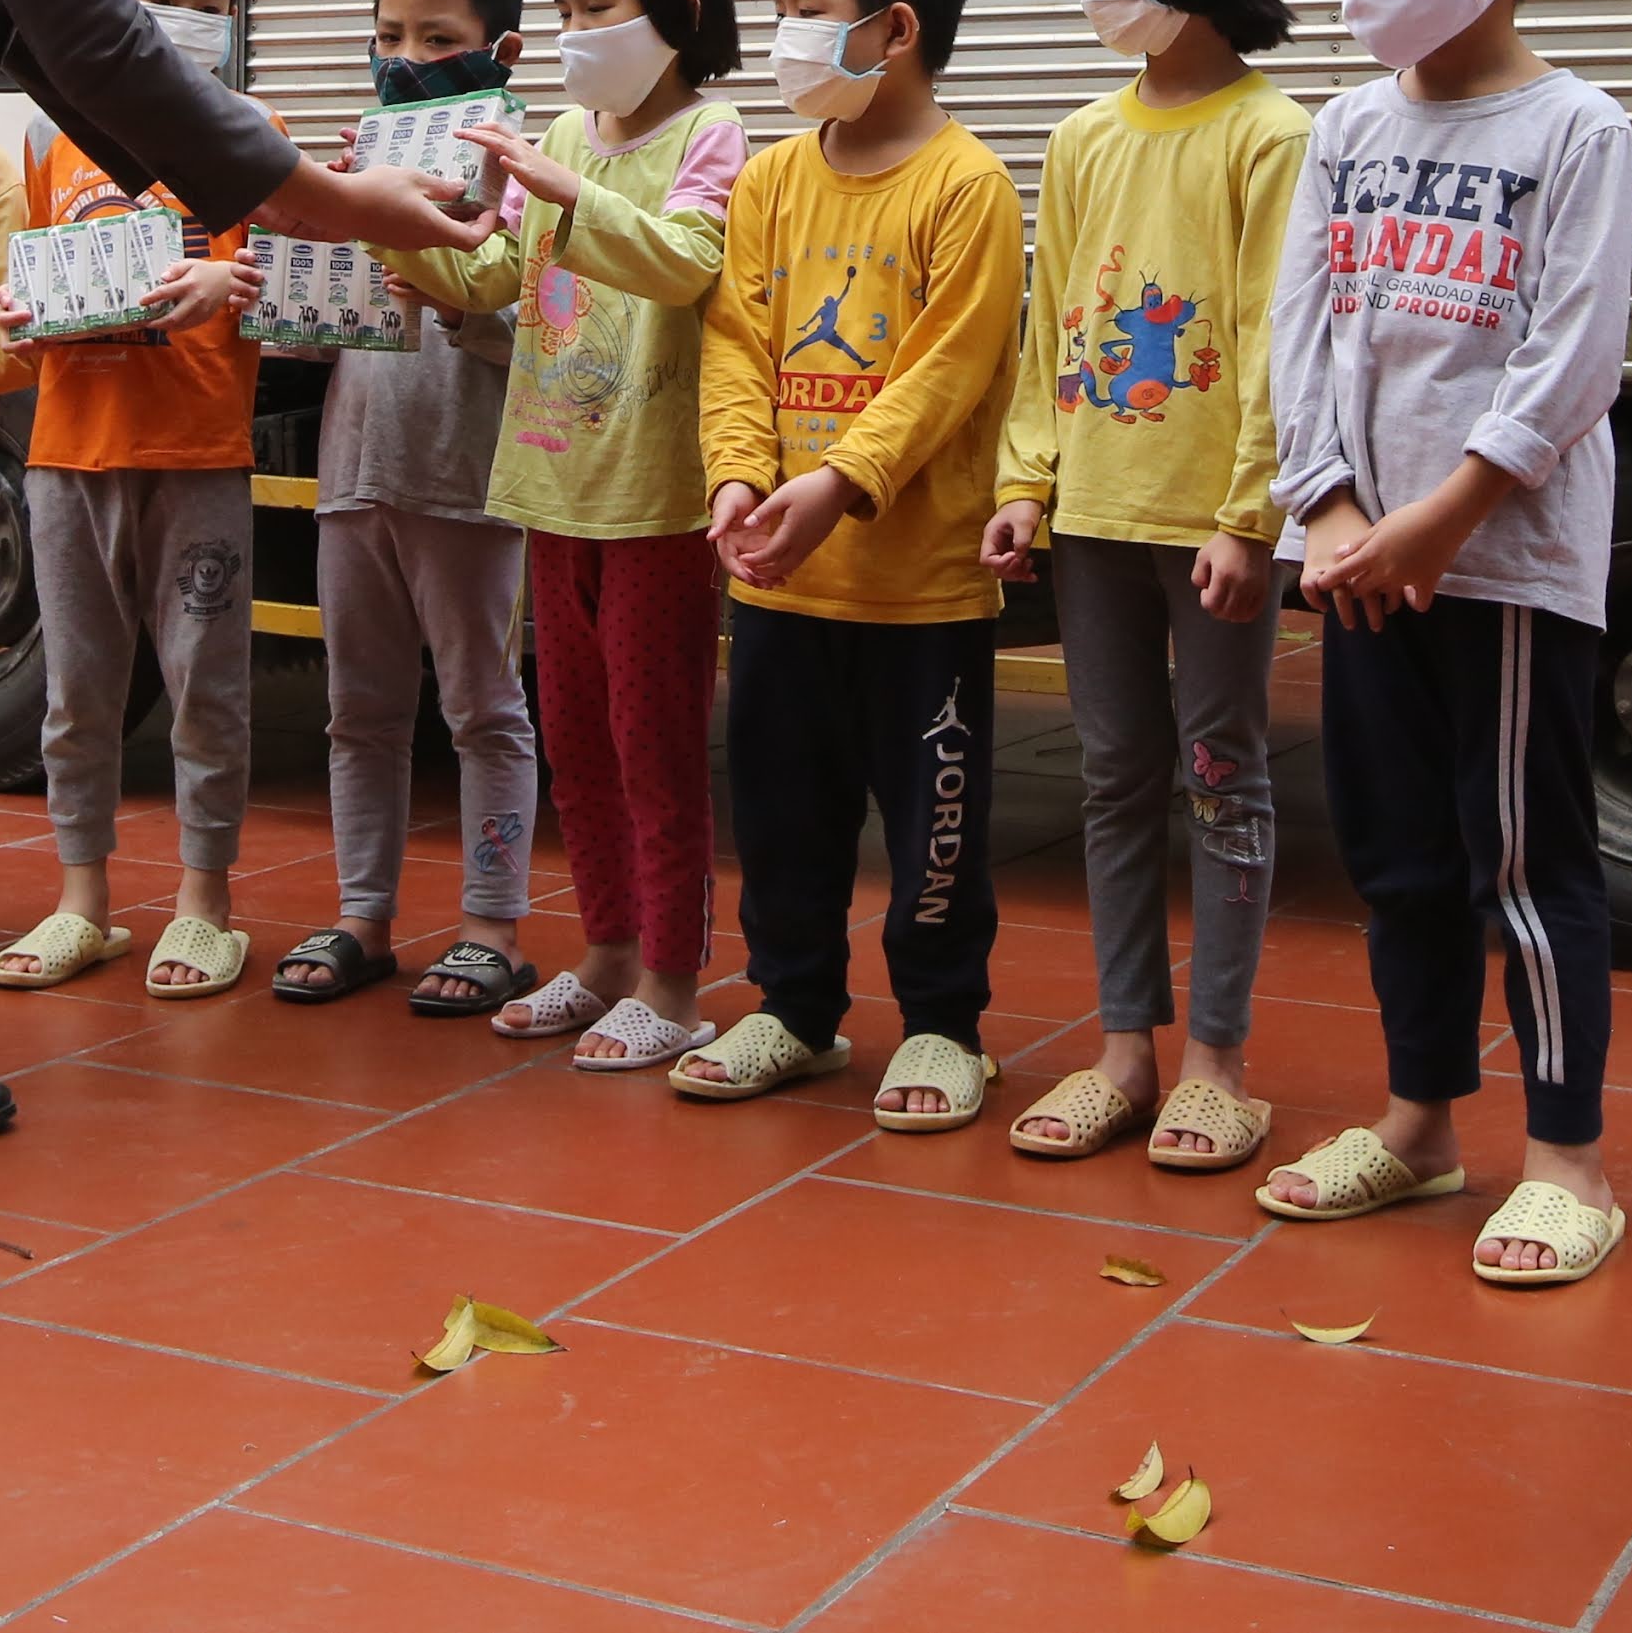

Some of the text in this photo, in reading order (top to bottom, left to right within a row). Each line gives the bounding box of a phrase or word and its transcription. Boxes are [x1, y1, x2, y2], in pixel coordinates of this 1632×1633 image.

[291, 258, 313, 268] 100%
[330, 261, 353, 270] 100%
[1365, 291, 1391, 310] ND
[1394, 294, 1501, 330] PROUDER
[1386, 277, 1473, 303] GRANDAD
[1478, 292, 1517, 313] BUT
[868, 312, 888, 342] 3
[914, 742, 965, 925] JORDAN
